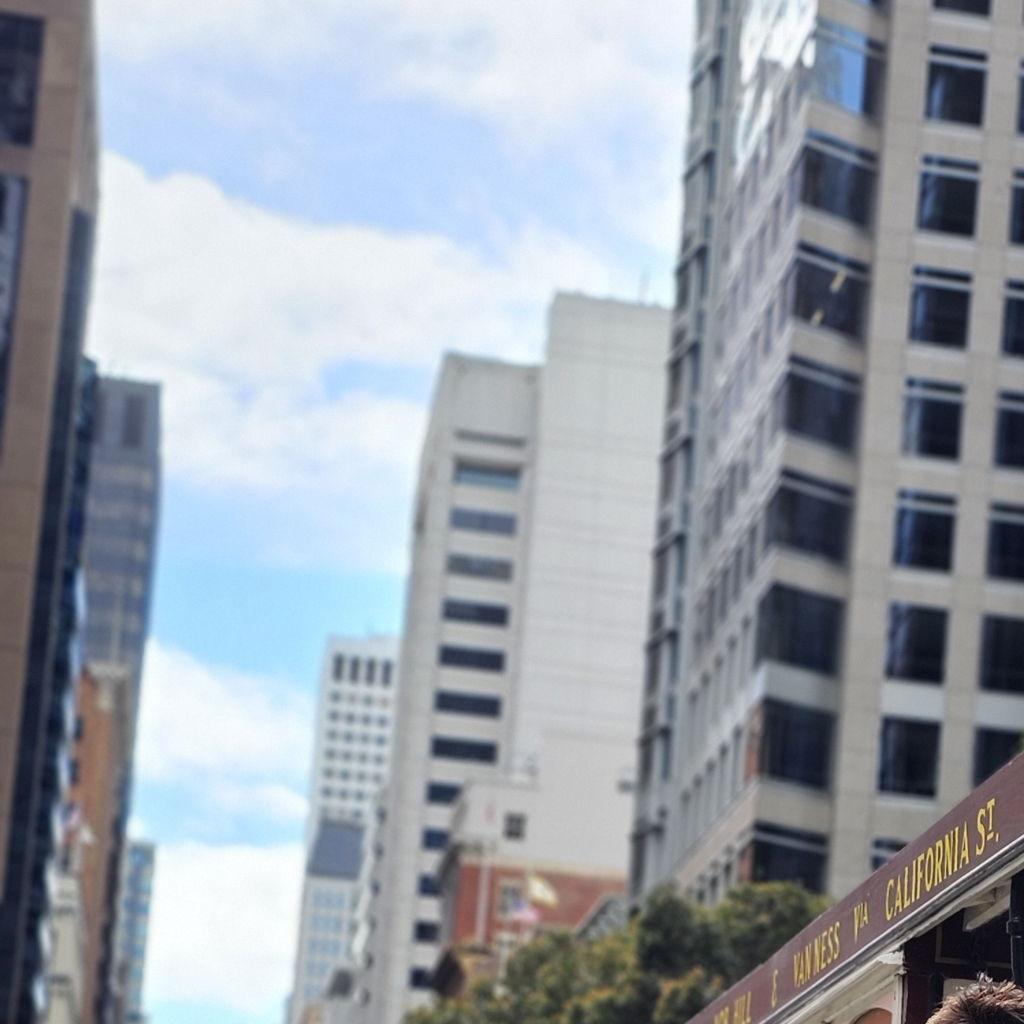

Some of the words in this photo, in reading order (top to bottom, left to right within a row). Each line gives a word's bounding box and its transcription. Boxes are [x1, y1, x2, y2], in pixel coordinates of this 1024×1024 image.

[793, 943, 812, 988] VAN
[814, 921, 840, 975] NESS
[853, 901, 869, 942] VIA
[884, 821, 970, 921] CALIFORNIA
